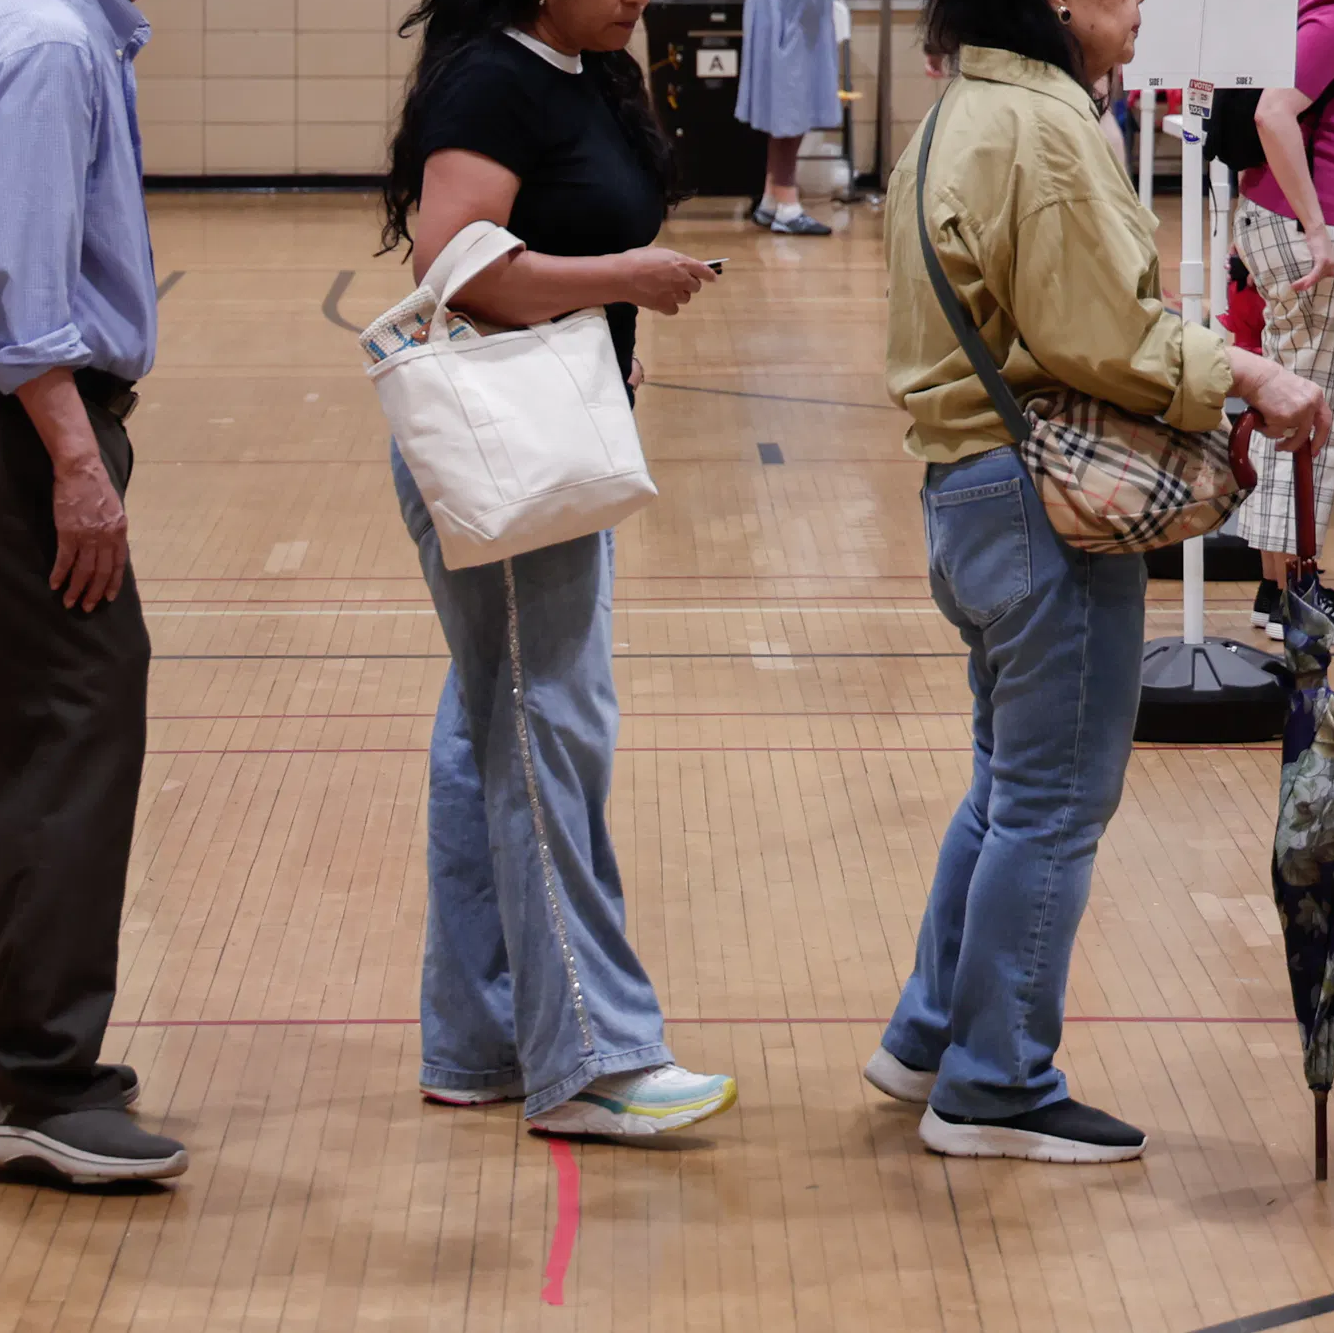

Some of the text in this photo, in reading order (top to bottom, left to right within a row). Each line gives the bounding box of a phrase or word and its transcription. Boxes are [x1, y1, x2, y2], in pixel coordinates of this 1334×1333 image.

[708, 54, 725, 73] A
[1149, 78, 1160, 86] SIDE
[1236, 77, 1248, 85] SIDE
[1193, 81, 1213, 92] VOTED
